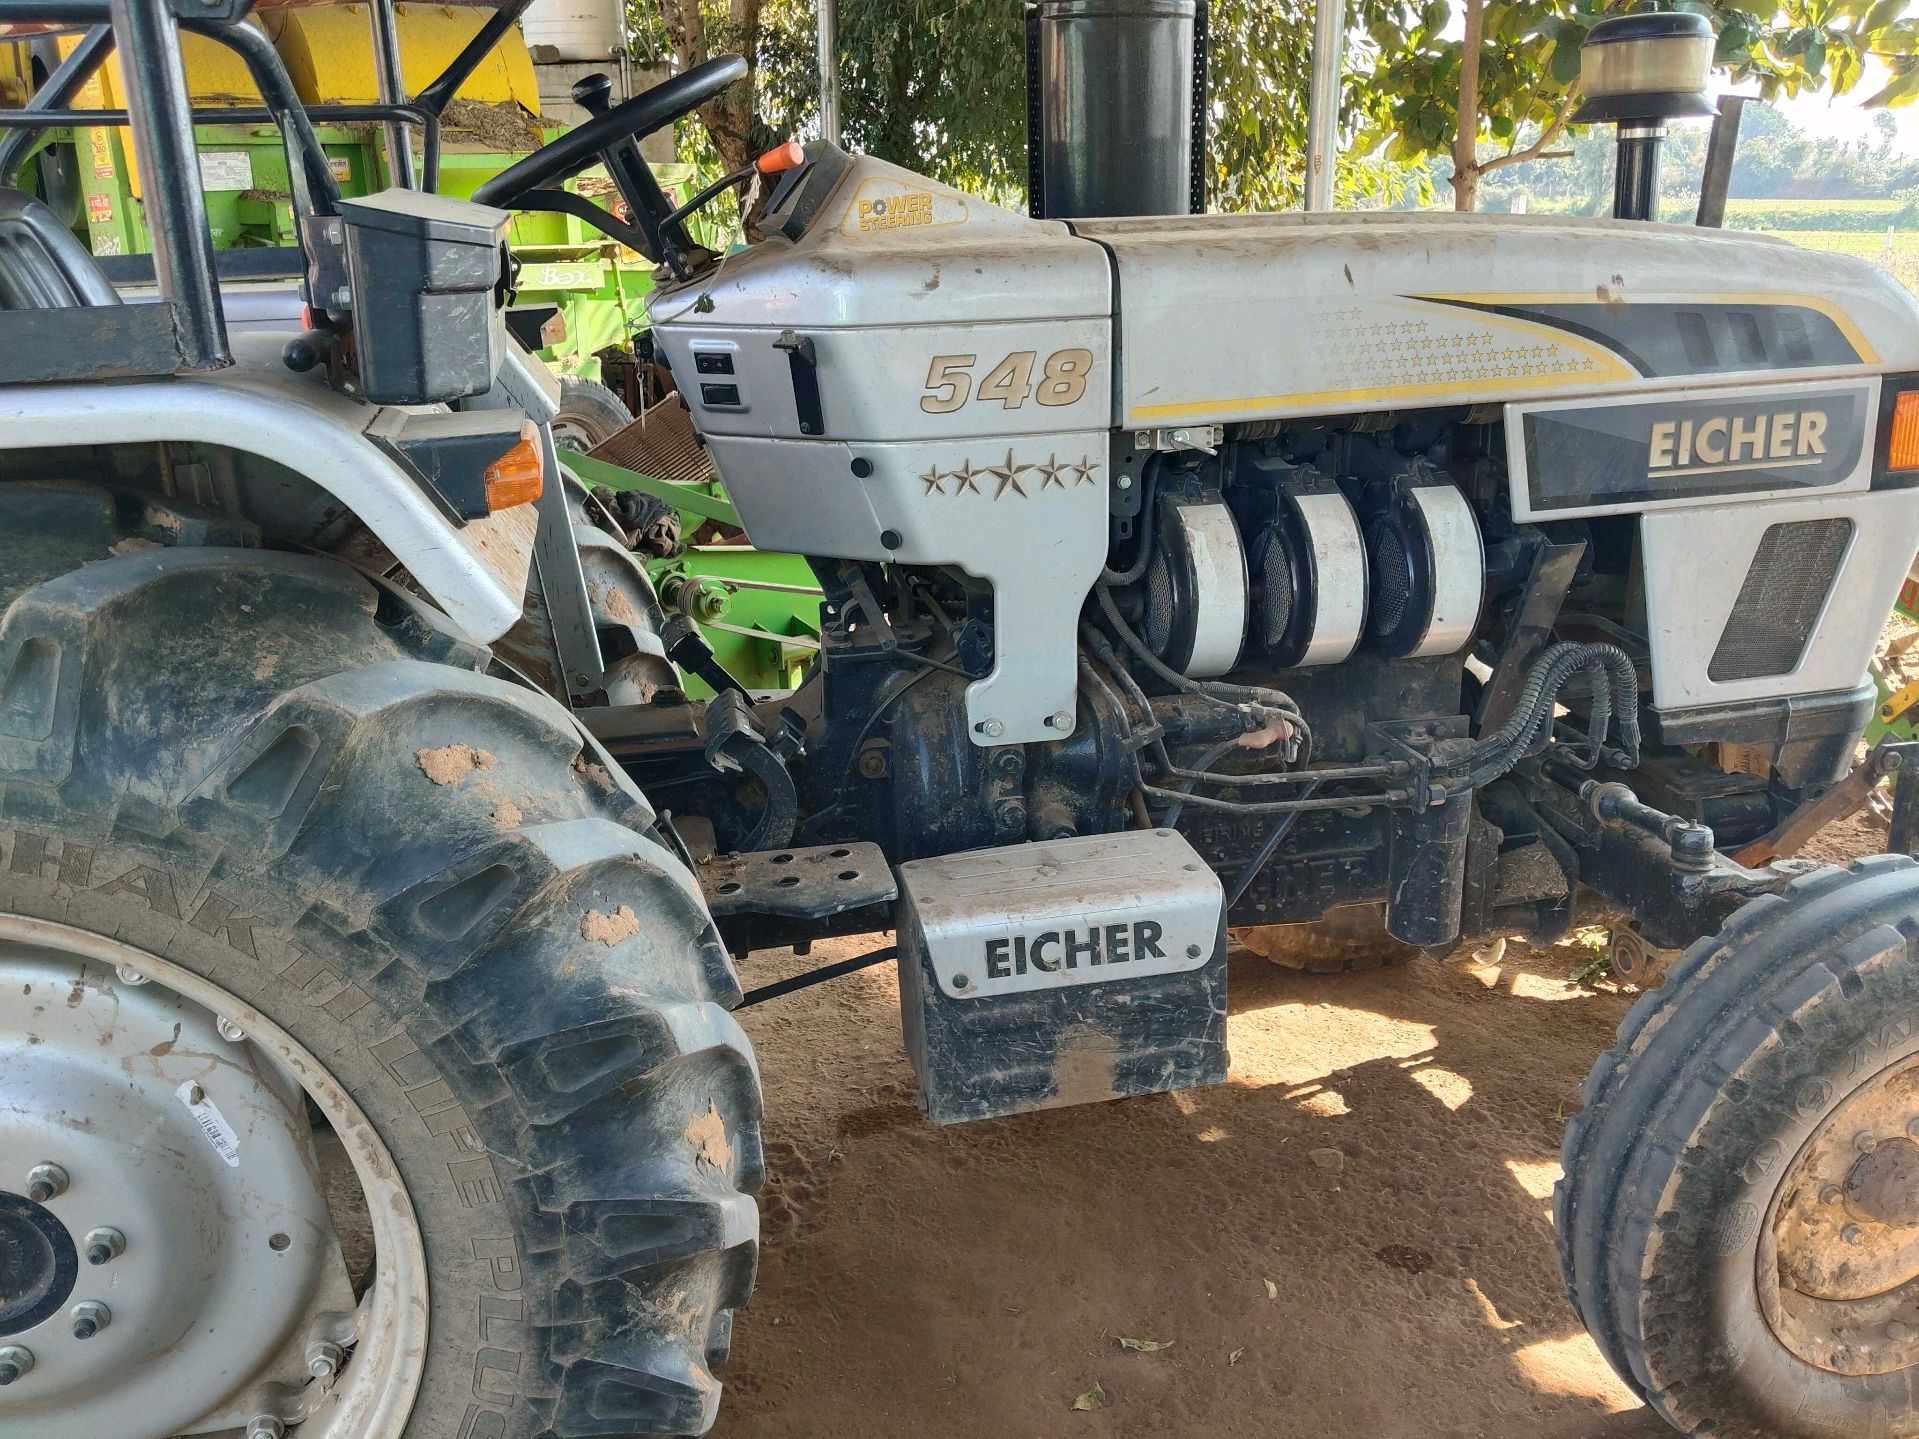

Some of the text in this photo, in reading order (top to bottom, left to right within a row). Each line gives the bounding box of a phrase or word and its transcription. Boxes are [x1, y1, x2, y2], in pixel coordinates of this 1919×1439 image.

[859, 192, 932, 218] POWER
[860, 211, 932, 231] STEERING
[920, 348, 1093, 414] 548
[1649, 411, 1828, 468] EICHER
[986, 920, 1167, 979] EICHER
[0, 830, 373, 1022] HAKTI
[367, 1031, 503, 1208] LIFE
